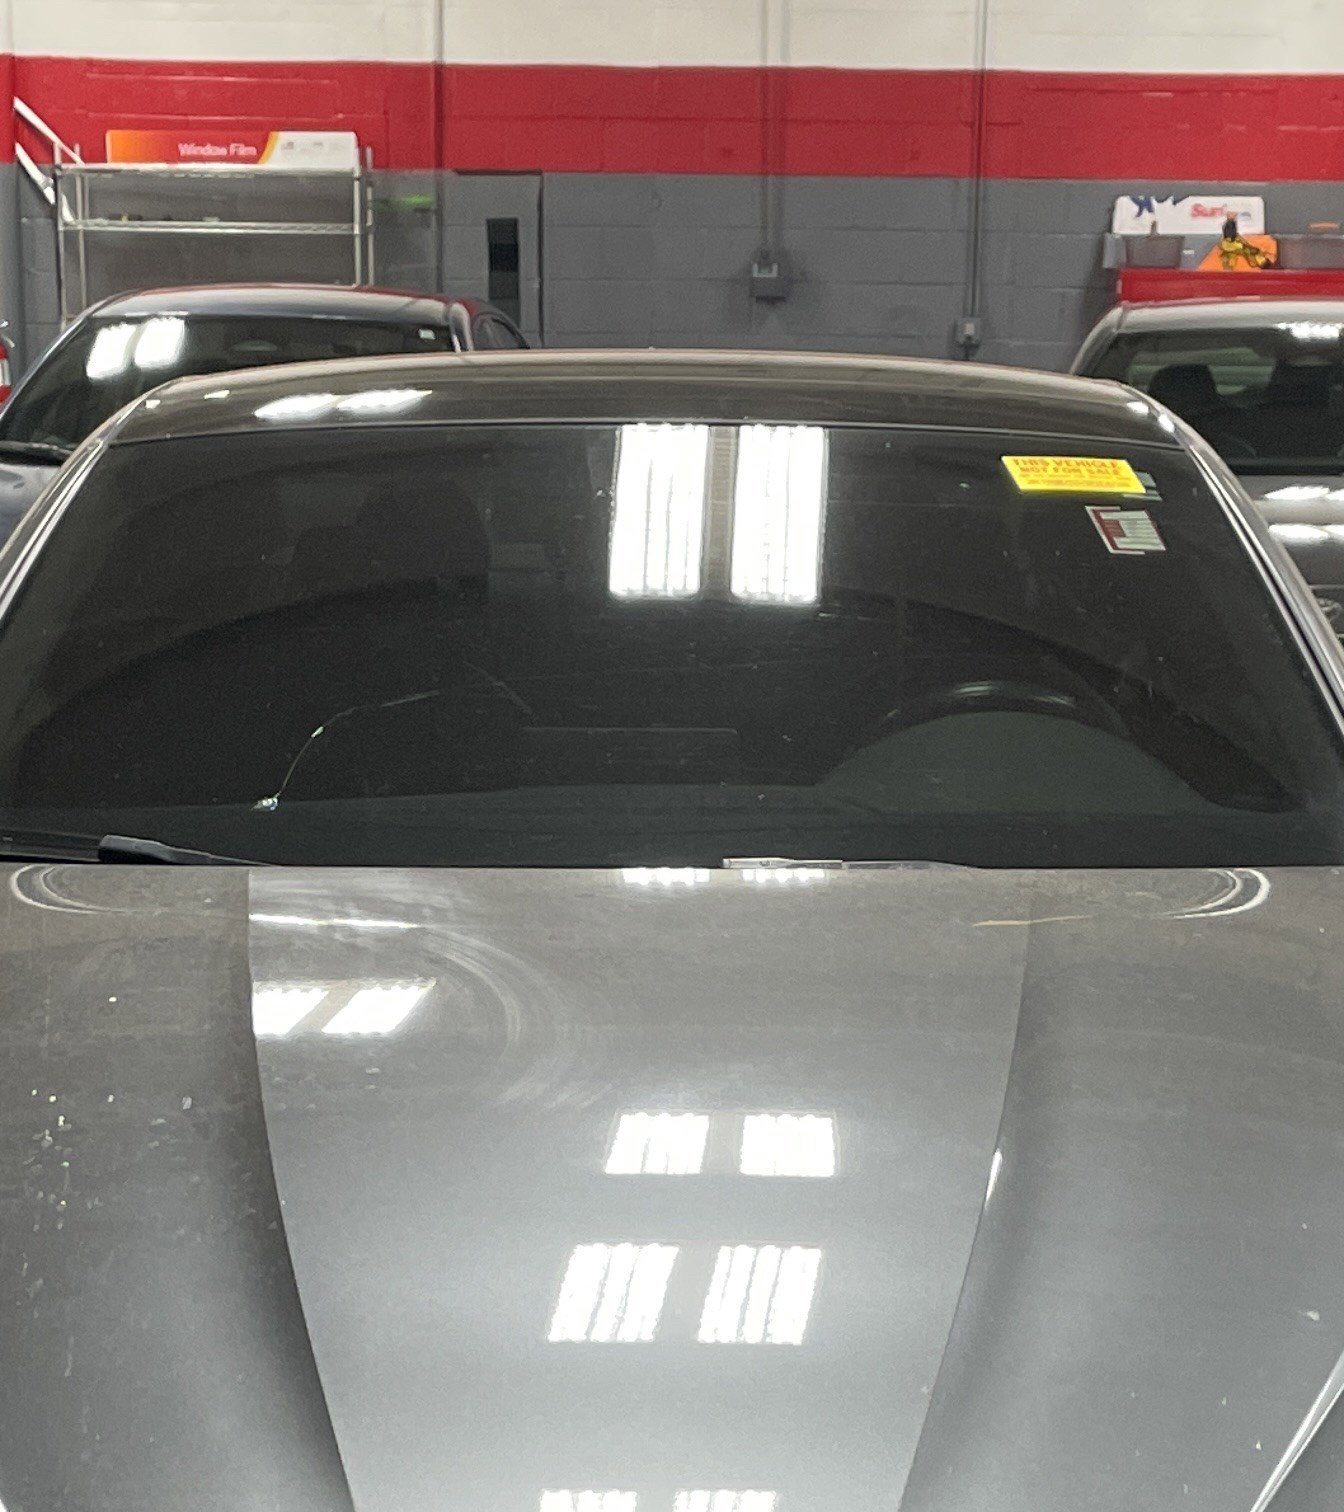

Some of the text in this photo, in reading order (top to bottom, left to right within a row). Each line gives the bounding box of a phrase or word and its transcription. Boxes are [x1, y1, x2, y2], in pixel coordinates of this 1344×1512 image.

[178, 142, 258, 156] Window Film
[1013, 458, 1050, 467] THIS
